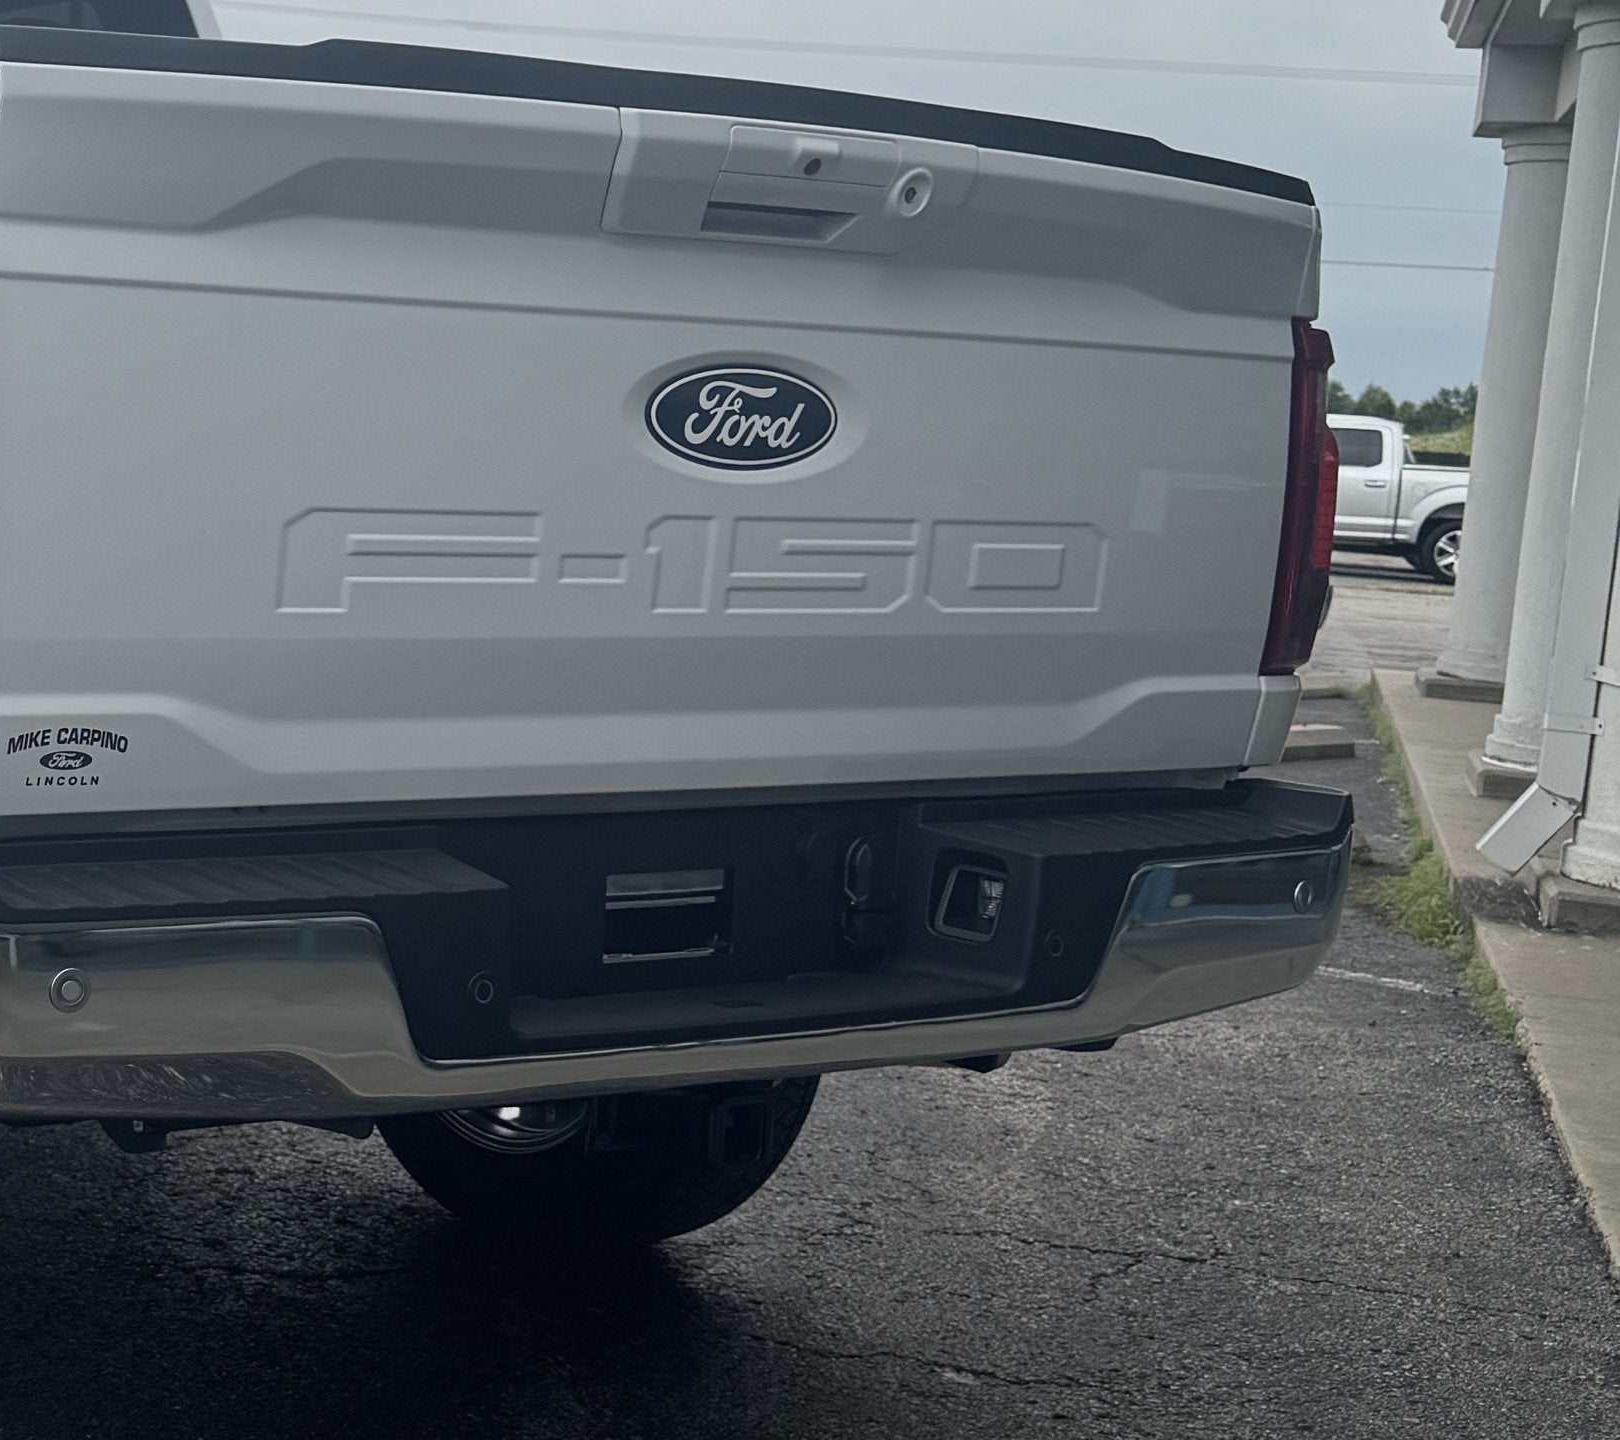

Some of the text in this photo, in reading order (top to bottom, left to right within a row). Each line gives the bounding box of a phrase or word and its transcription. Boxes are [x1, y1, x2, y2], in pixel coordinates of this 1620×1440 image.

[684, 380, 805, 449] Ford
[275, 506, 1109, 614] F-150
[7, 727, 129, 755] MIKE CARPINO
[25, 776, 100, 787] LINCOLN
